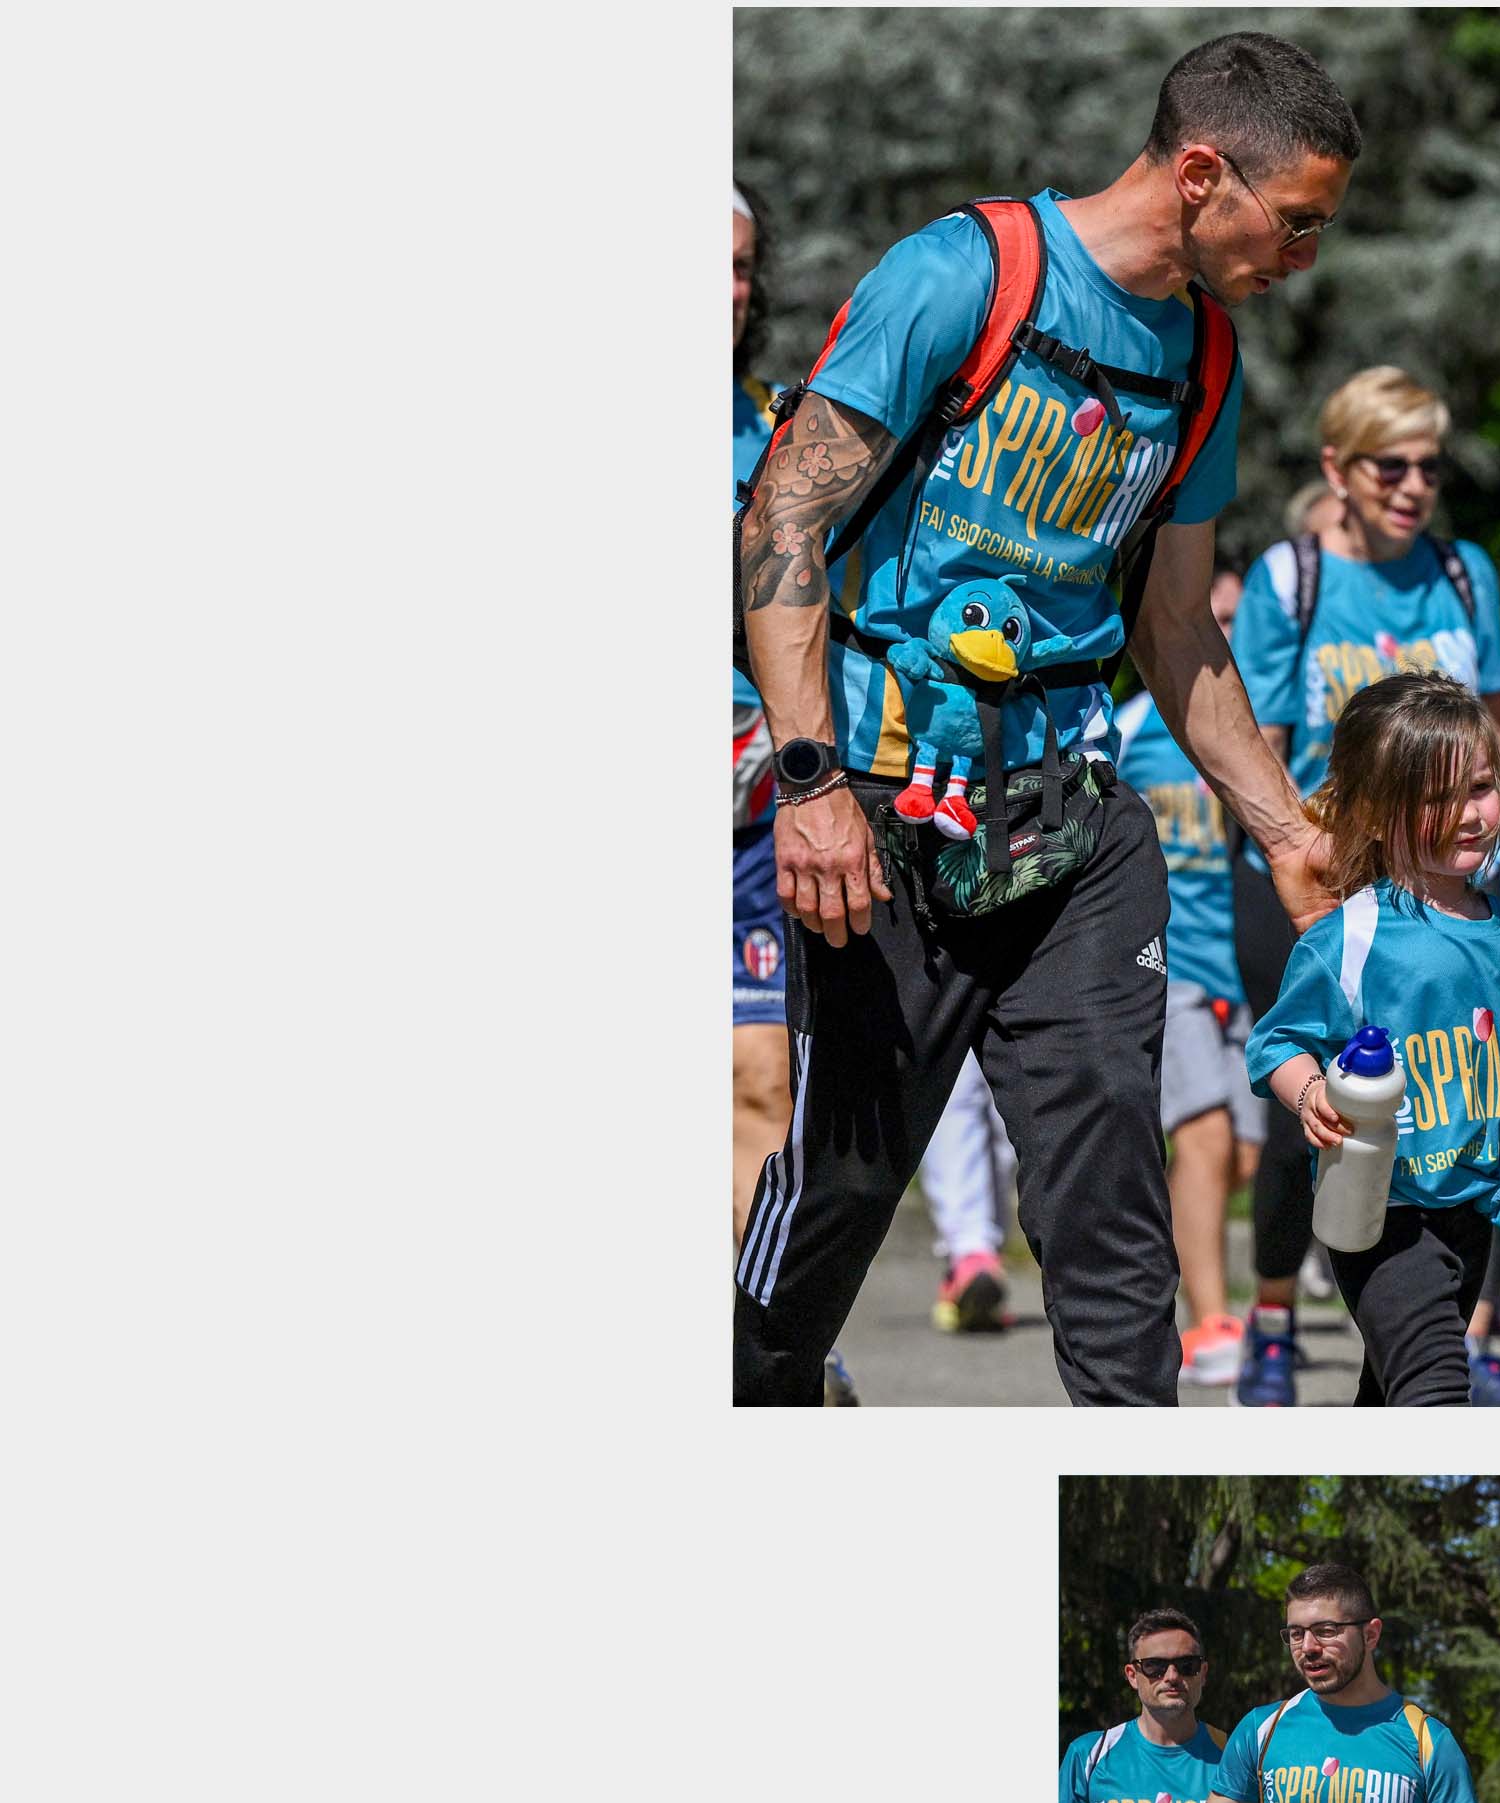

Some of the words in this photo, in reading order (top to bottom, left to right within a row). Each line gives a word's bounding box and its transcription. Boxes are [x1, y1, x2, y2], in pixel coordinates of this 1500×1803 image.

[919, 501, 945, 532] FAI
[947, 514, 1035, 571] SBOCCIARE
[1031, 552, 1054, 580] LA
